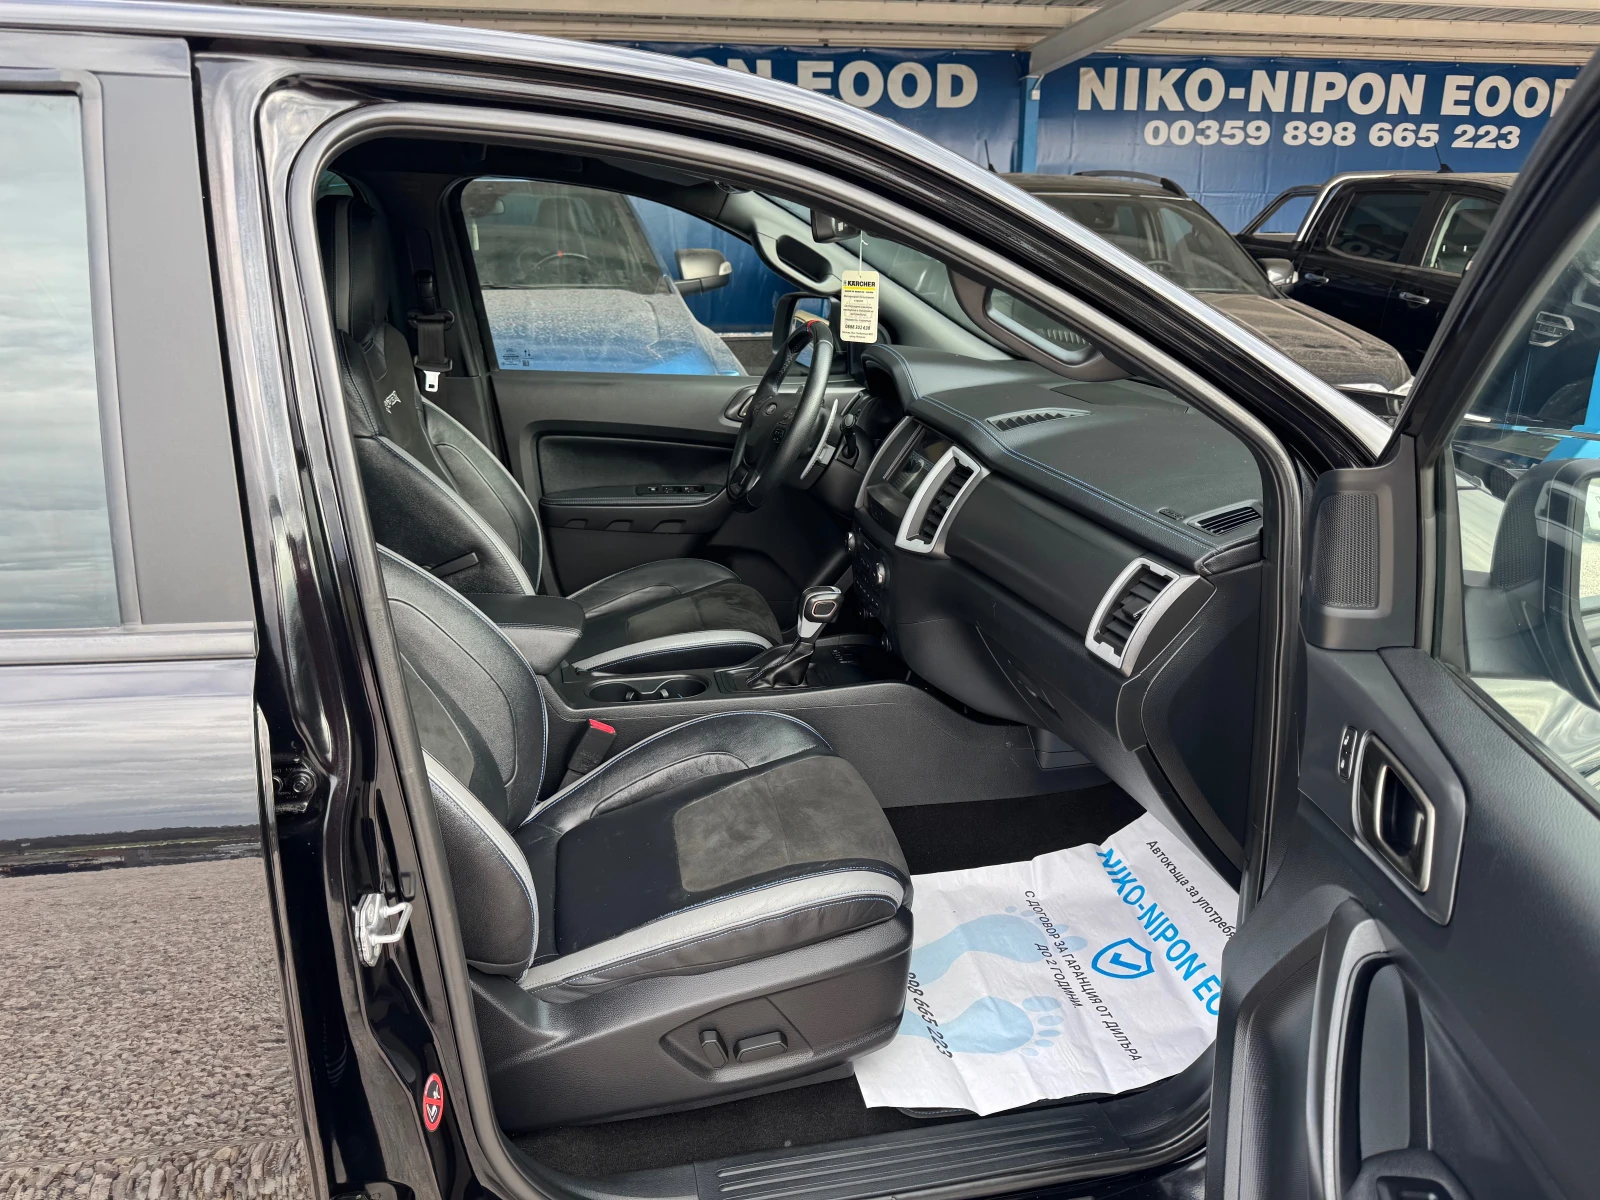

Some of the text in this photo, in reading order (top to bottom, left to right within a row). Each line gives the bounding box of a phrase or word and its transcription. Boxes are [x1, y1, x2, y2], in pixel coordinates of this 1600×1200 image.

[797, 60, 978, 109] EOOD
[1078, 67, 1425, 115] NIKO-NIPON
[1144, 119, 1521, 150] 00359 898 665 223
[1146, 840, 1190, 887] Автокъща
[1185, 885, 1199, 898] за
[1026, 899, 1060, 940] ДОГОВОР
[1096, 848, 1207, 982] NIKO-NIPON
[1054, 937, 1069, 954] ЗА
[1034, 942, 1052, 958] ДО
[1050, 967, 1084, 1008] ГОДИНИ.
[1062, 953, 1101, 1004] ГАРАНЦИЯ
[913, 997, 938, 1027] 665
[926, 1025, 953, 1058] 223
[1095, 1005, 1113, 1019] ОТ
[1102, 1019, 1142, 1061] ДИЛЪРА
